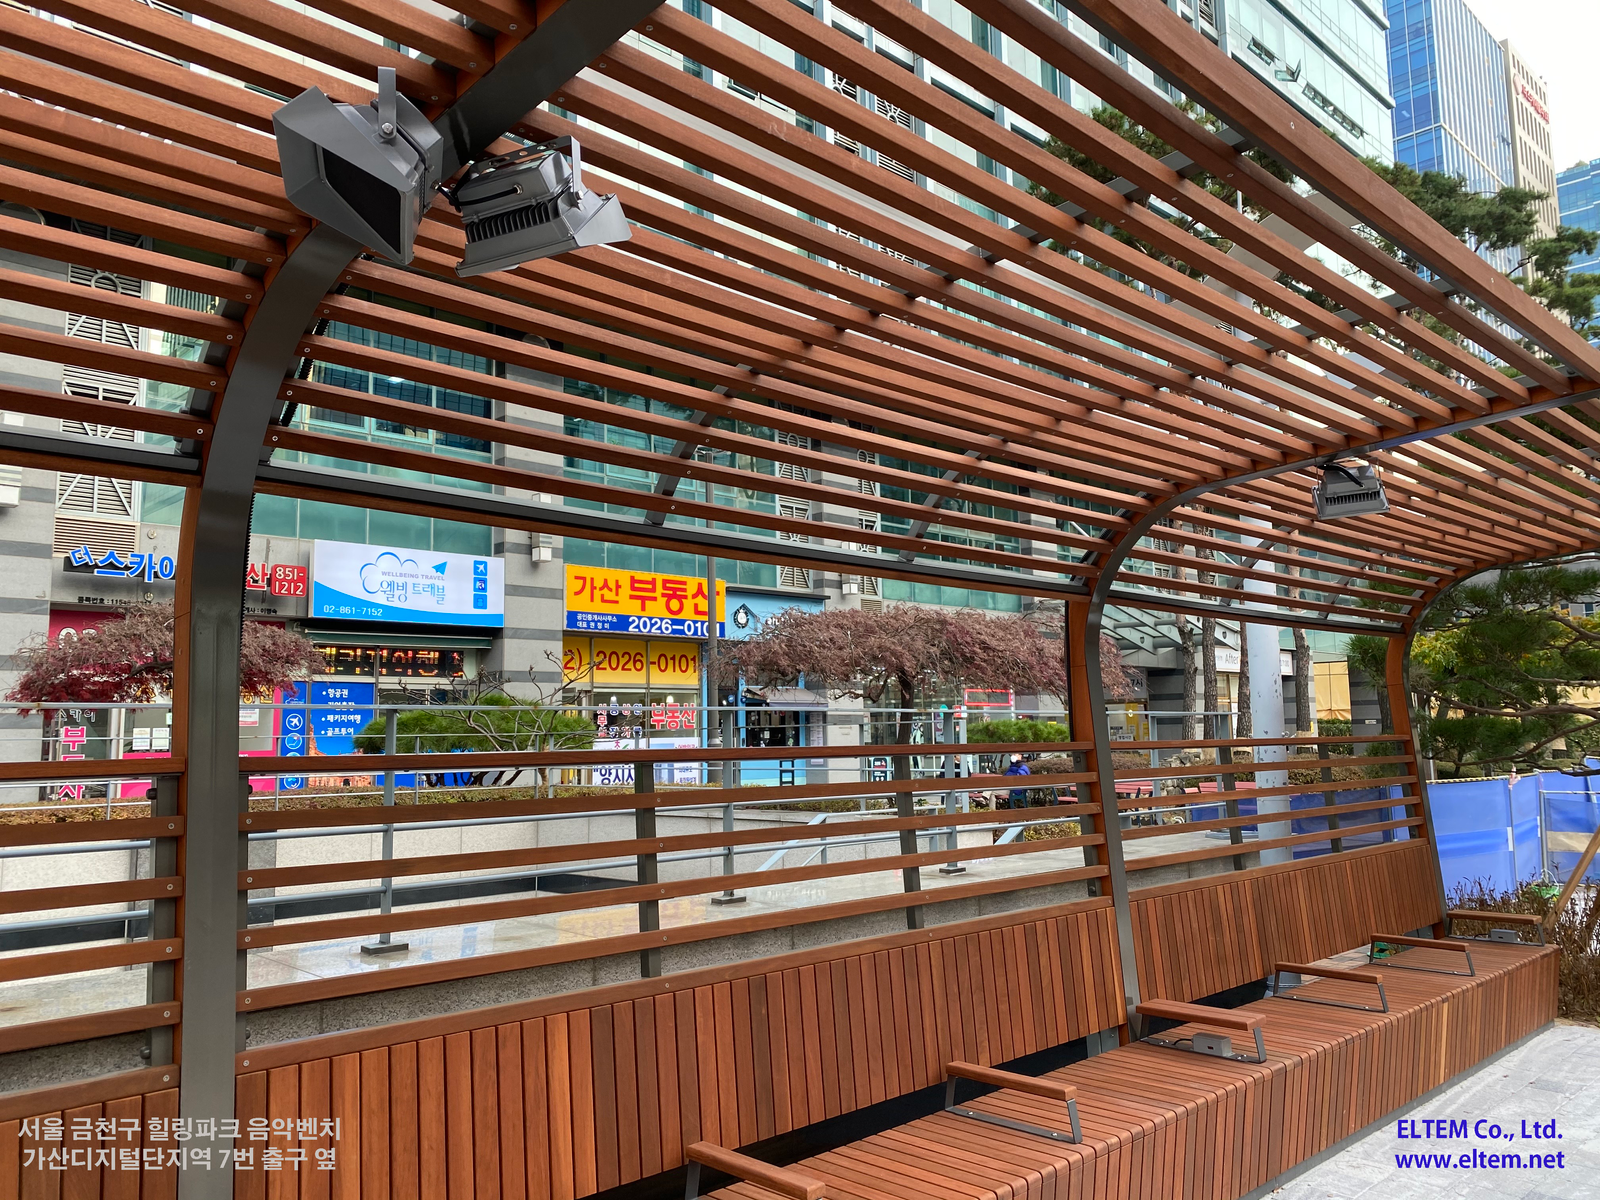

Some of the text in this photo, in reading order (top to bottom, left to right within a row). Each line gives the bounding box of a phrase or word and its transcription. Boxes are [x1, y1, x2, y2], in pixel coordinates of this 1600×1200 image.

[275, 566, 304, 580] 851-
[381, 571, 419, 579] WELLBEING
[275, 581, 304, 595] 1212
[380, 580, 446, 606] 웰빙 트래블
[574, 575, 720, 616] 가산 부동산
[323, 604, 383, 617] 02-861-7152
[576, 613, 617, 622] 공인중개사사무소
[327, 688, 349, 698] 항공권
[326, 714, 361, 724] 패키지여행
[651, 703, 696, 730] 부동산
[326, 727, 354, 736] 골프투어
